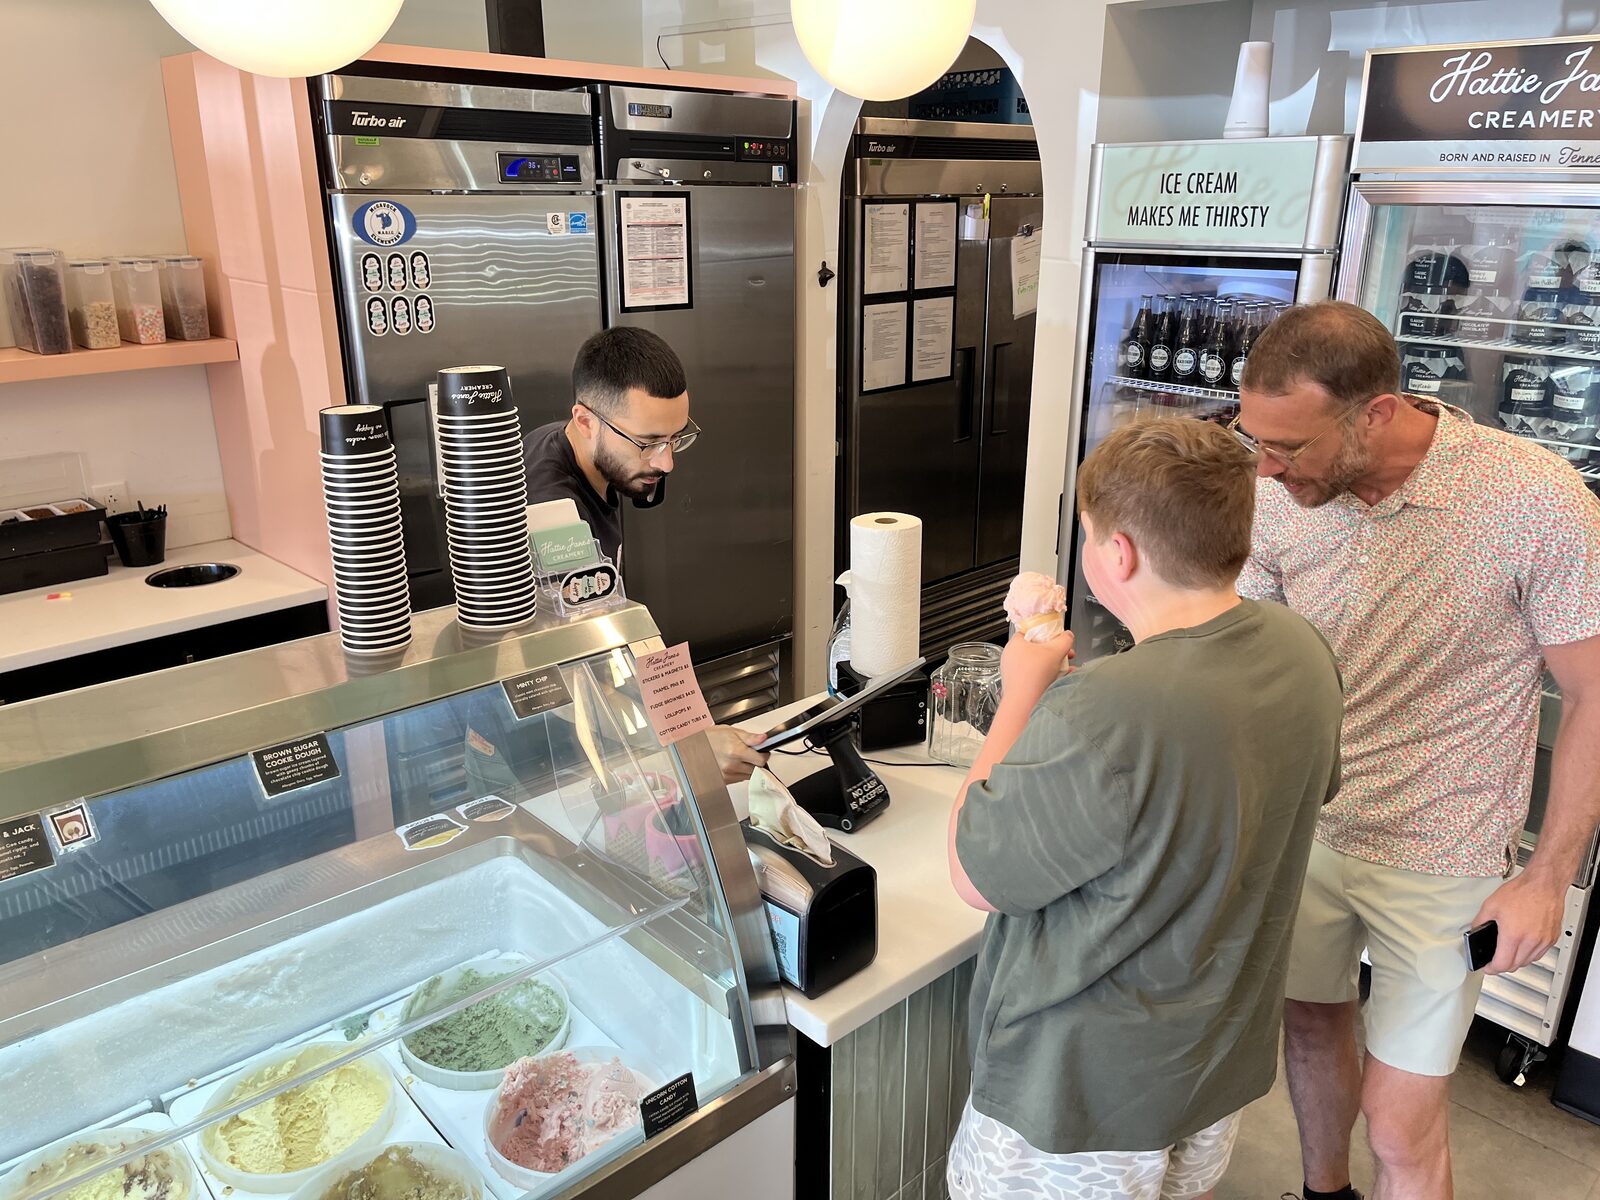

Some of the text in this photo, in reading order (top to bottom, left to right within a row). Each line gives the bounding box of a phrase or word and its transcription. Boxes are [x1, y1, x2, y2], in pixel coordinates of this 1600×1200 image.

[1430, 52, 1542, 102] Hattie
[352, 111, 406, 128] Turbo air
[868, 142, 896, 152] Turbo air
[1440, 153, 1468, 162] BORN
[1472, 153, 1494, 162] AND
[1498, 153, 1536, 162] RAISED
[1539, 153, 1551, 162] IN
[1160, 172, 1237, 194] ICE CREAM
[1127, 206, 1269, 227] MAKES ME THIRSTY
[642, 674, 660, 684] STICKERS
[665, 667, 683, 676] MAGNETS
[516, 680, 534, 689] MINTY
[653, 686, 669, 694] ENAMEL
[650, 702, 663, 710] FUDGE
[664, 708, 686, 719] LOLLIPOPS
[659, 726, 676, 736] COTTON
[677, 721, 690, 730] CANDY
[263, 741, 319, 761] BROWN SUGAR
[266, 748, 321, 768] COOKIE DOUGH
[850, 784, 884, 810] IS ACCEPTED
[852, 788, 863, 798] NO
[863, 779, 878, 791] CASH
[645, 1078, 688, 1105] UNICORN COTTON
[660, 1092, 676, 1105] CANDY
